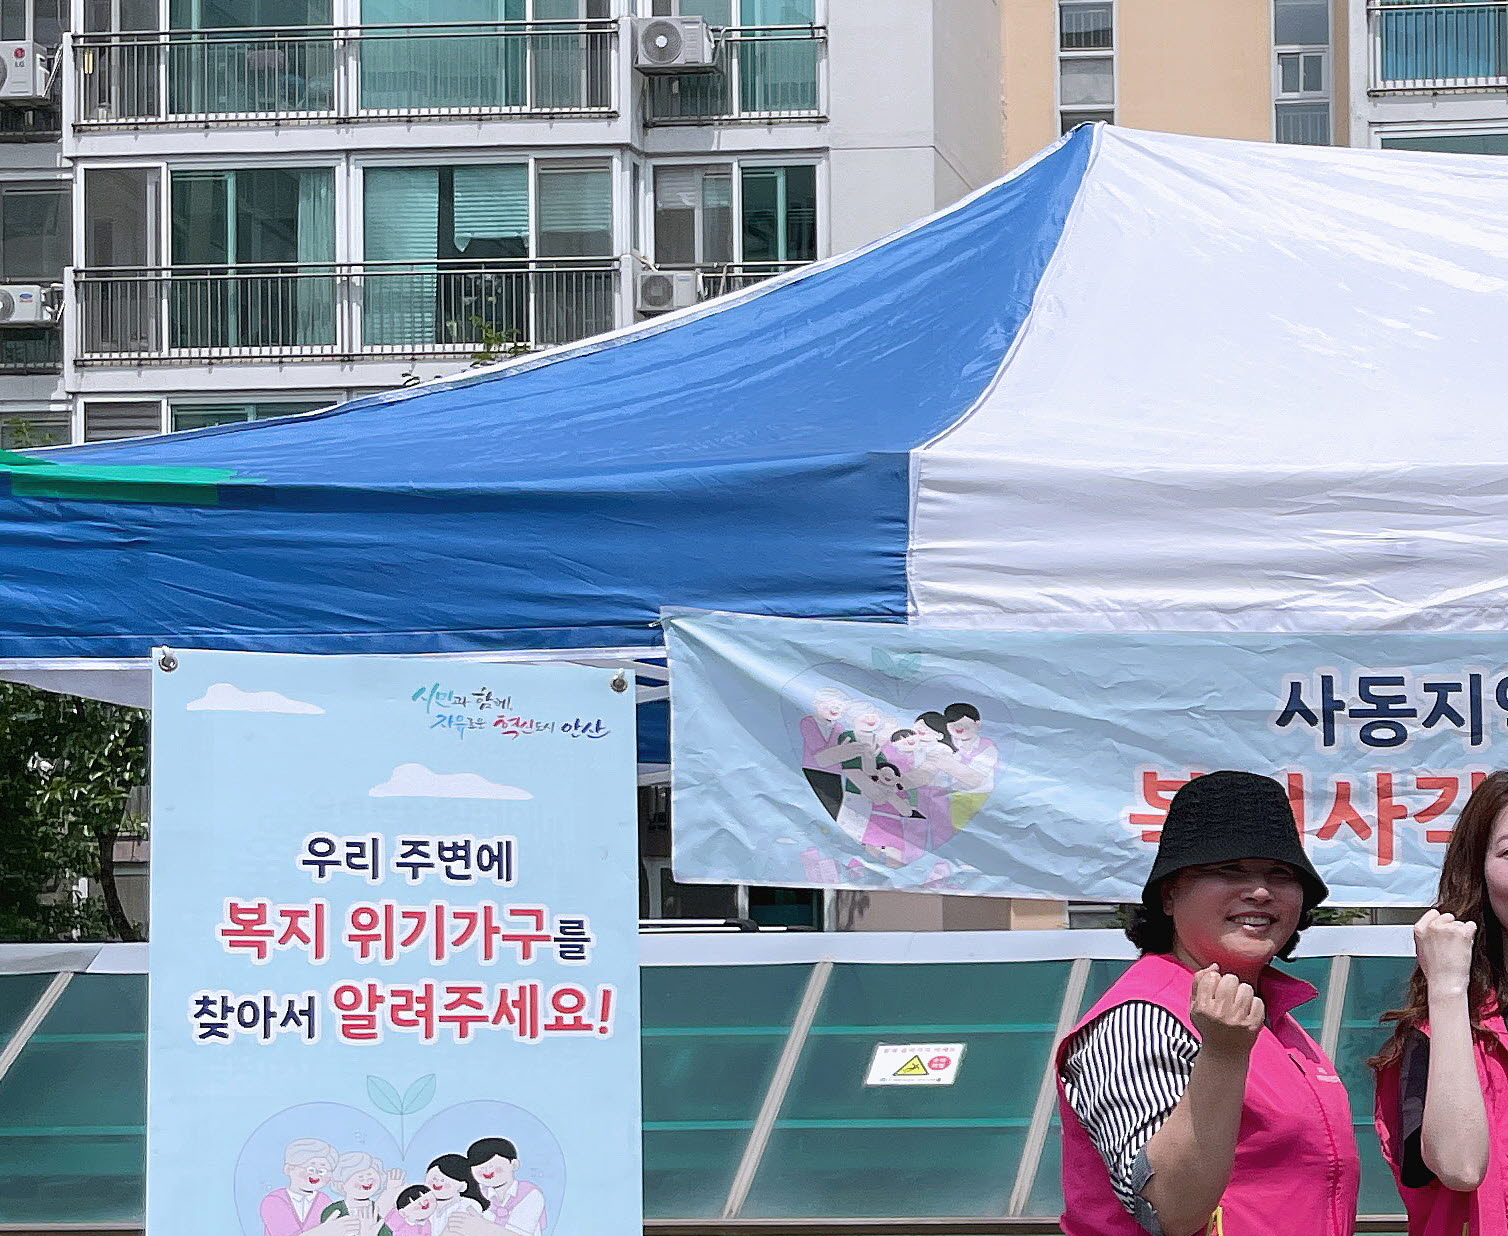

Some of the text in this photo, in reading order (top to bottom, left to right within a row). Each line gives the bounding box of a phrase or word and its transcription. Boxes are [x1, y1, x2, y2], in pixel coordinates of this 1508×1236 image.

[412, 683, 469, 713] 시민과
[430, 714, 611, 740] 자유로운 혁신도시 안산
[301, 837, 513, 882] 우리 주변에
[221, 903, 591, 961] 복지 위기가구를
[194, 984, 611, 1040] 찾아서 알려주세요!
